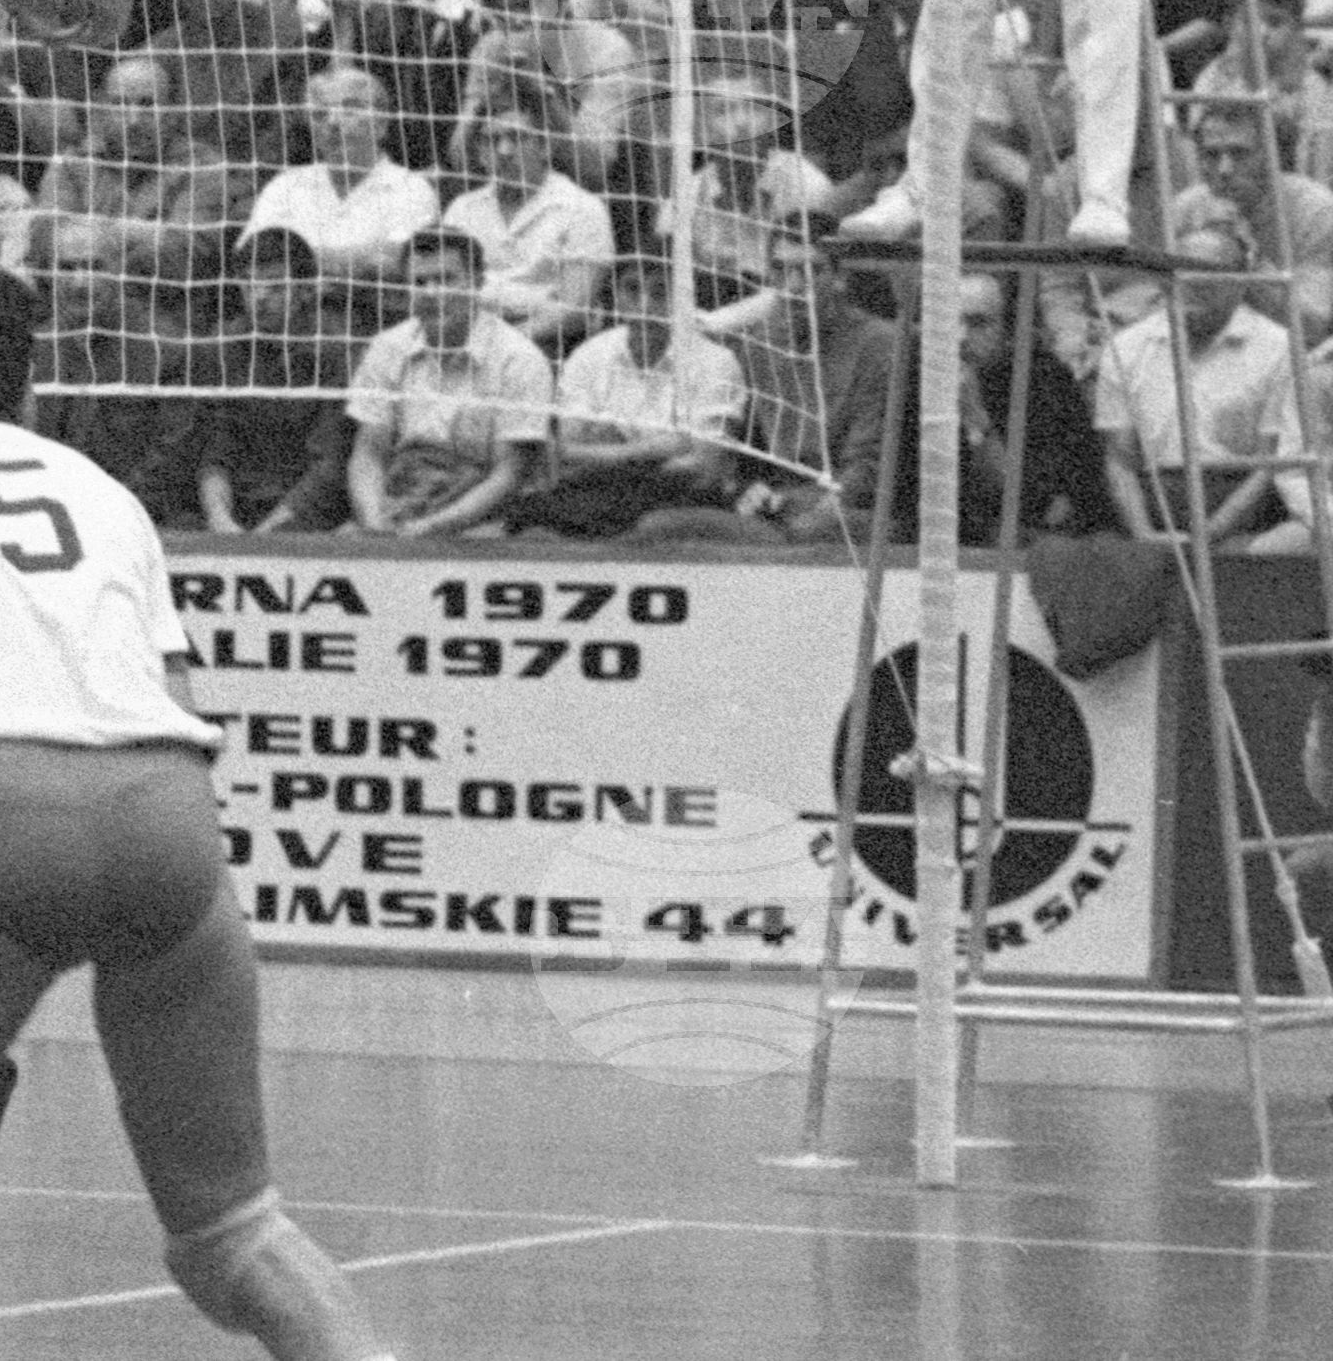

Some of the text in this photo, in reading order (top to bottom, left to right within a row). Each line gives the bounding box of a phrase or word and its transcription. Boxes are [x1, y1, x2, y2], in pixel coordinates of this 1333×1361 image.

[168, 571, 690, 626] RNA 1970
[397, 634, 642, 682] 1970
[216, 772, 719, 828] -POLOGNE
[242, 885, 796, 946] IMSKIE 44
